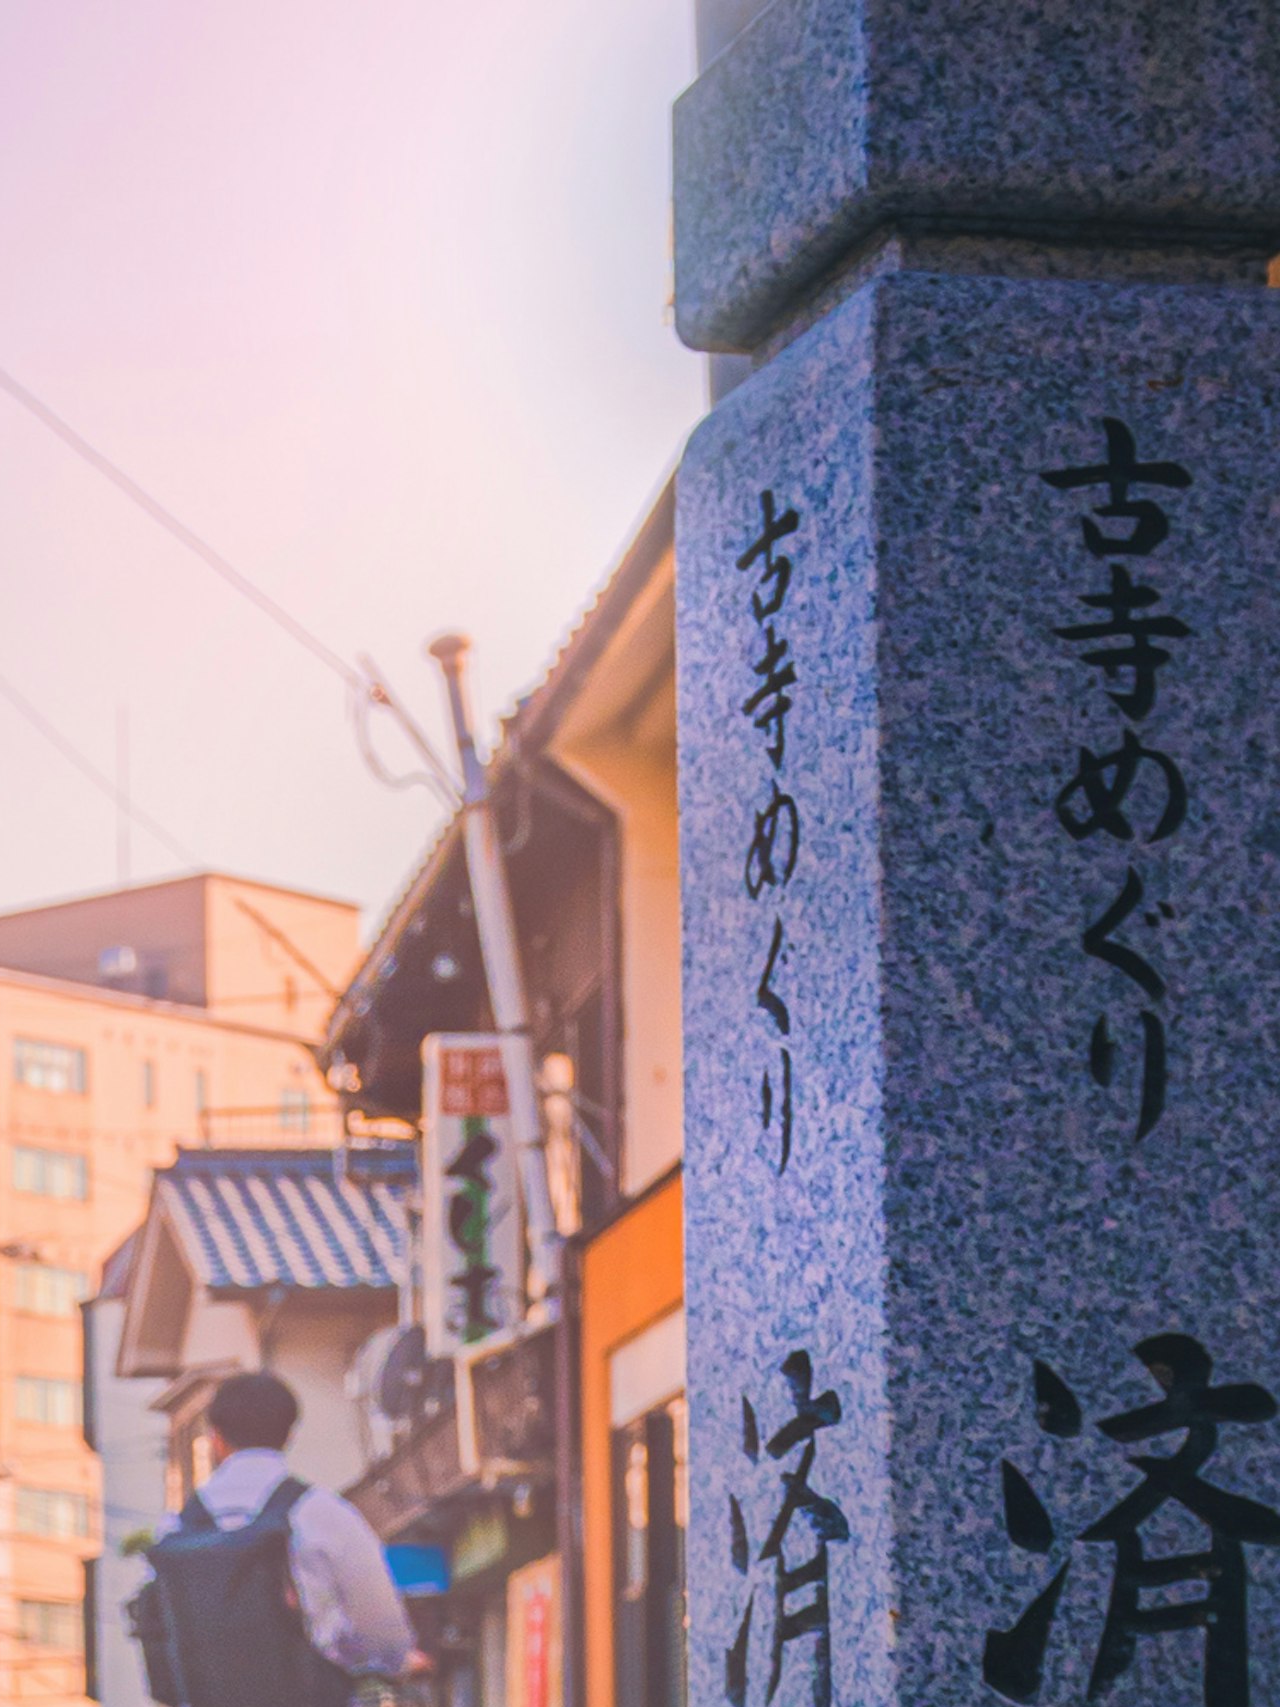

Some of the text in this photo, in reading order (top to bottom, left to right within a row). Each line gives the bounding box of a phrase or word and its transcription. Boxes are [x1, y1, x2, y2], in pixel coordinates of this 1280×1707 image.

[735, 489, 800, 1177] 古寺めぐり
[1040, 416, 1194, 1144] 古寺めぐり
